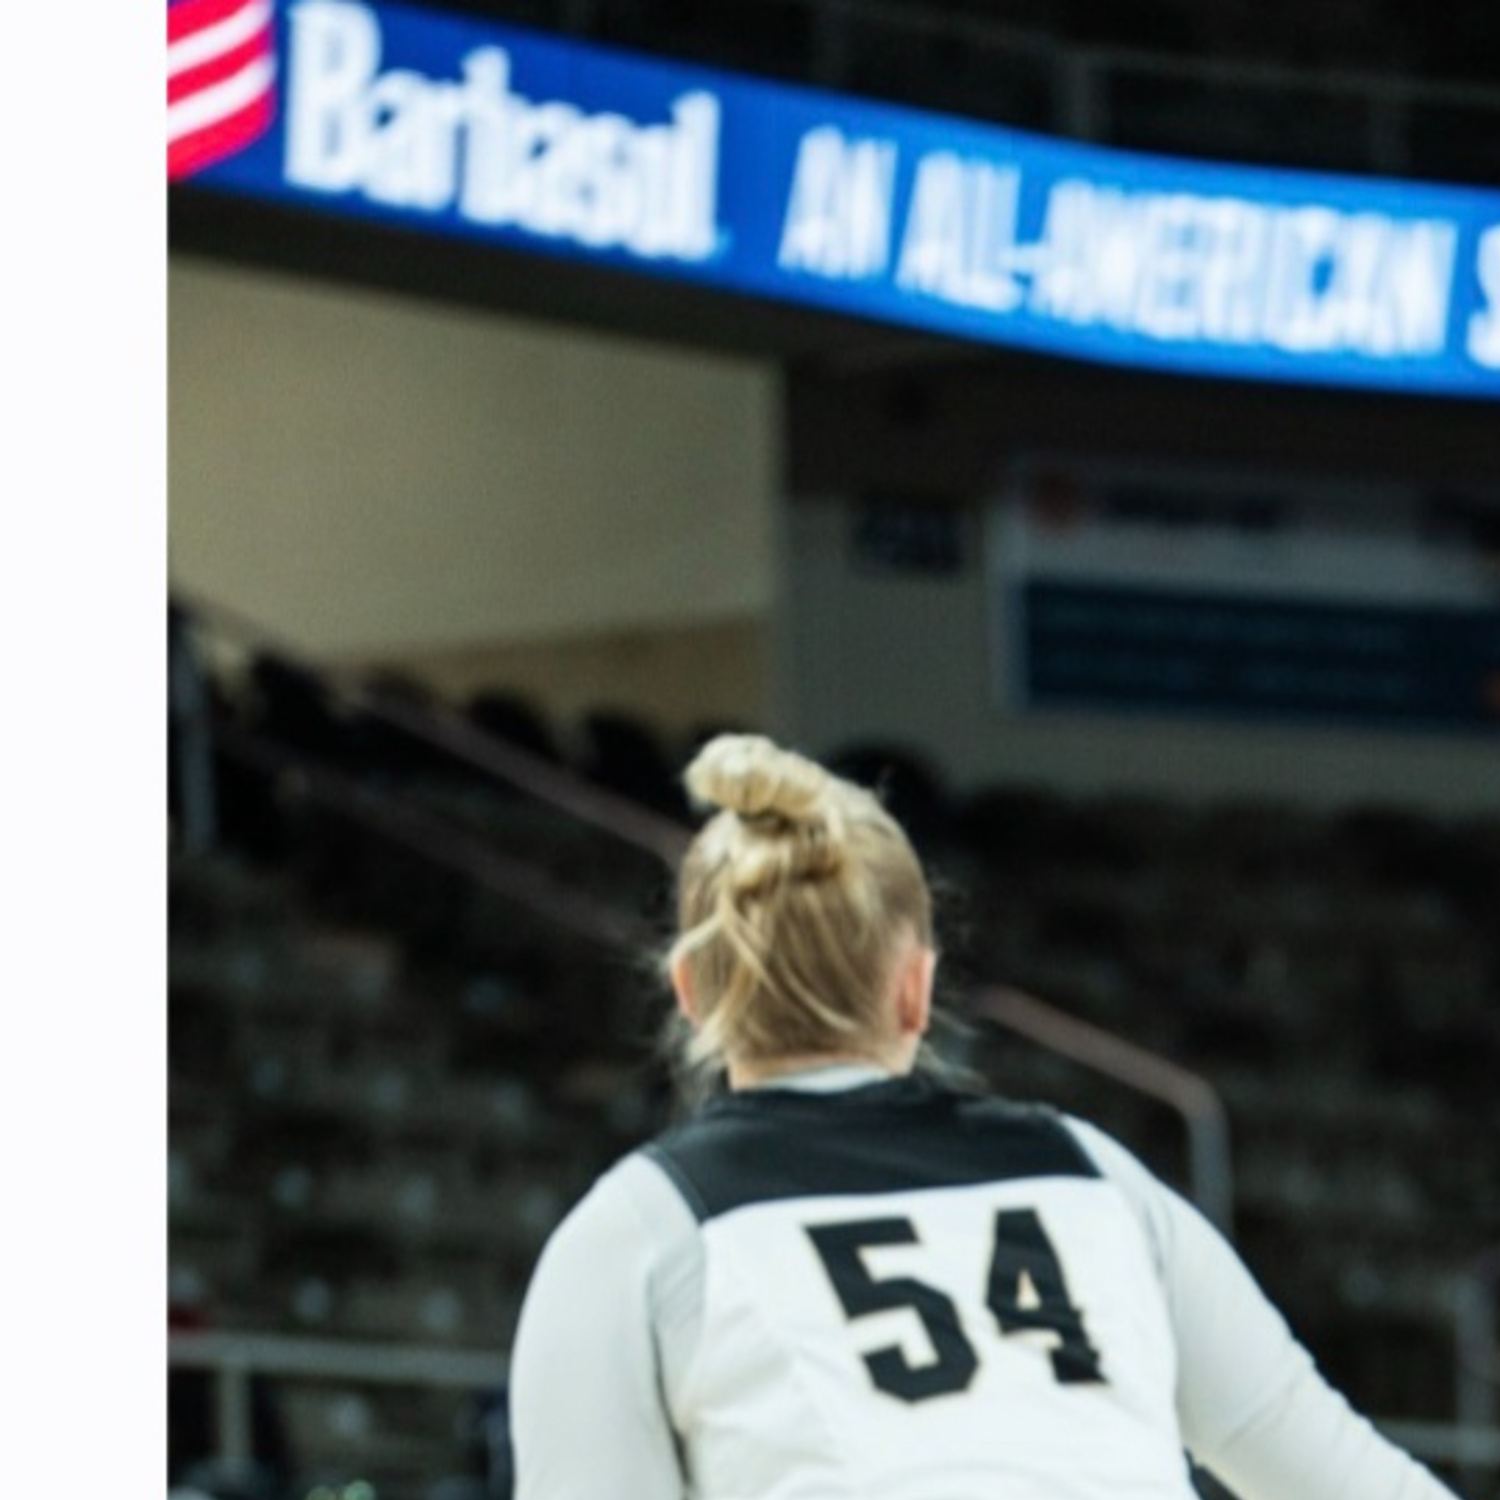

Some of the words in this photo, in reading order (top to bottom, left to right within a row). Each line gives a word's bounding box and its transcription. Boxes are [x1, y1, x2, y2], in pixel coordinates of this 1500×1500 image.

[283, 0, 717, 262] Barbasol
[778, 125, 898, 279] AN
[803, 1208, 1110, 1404] 54
